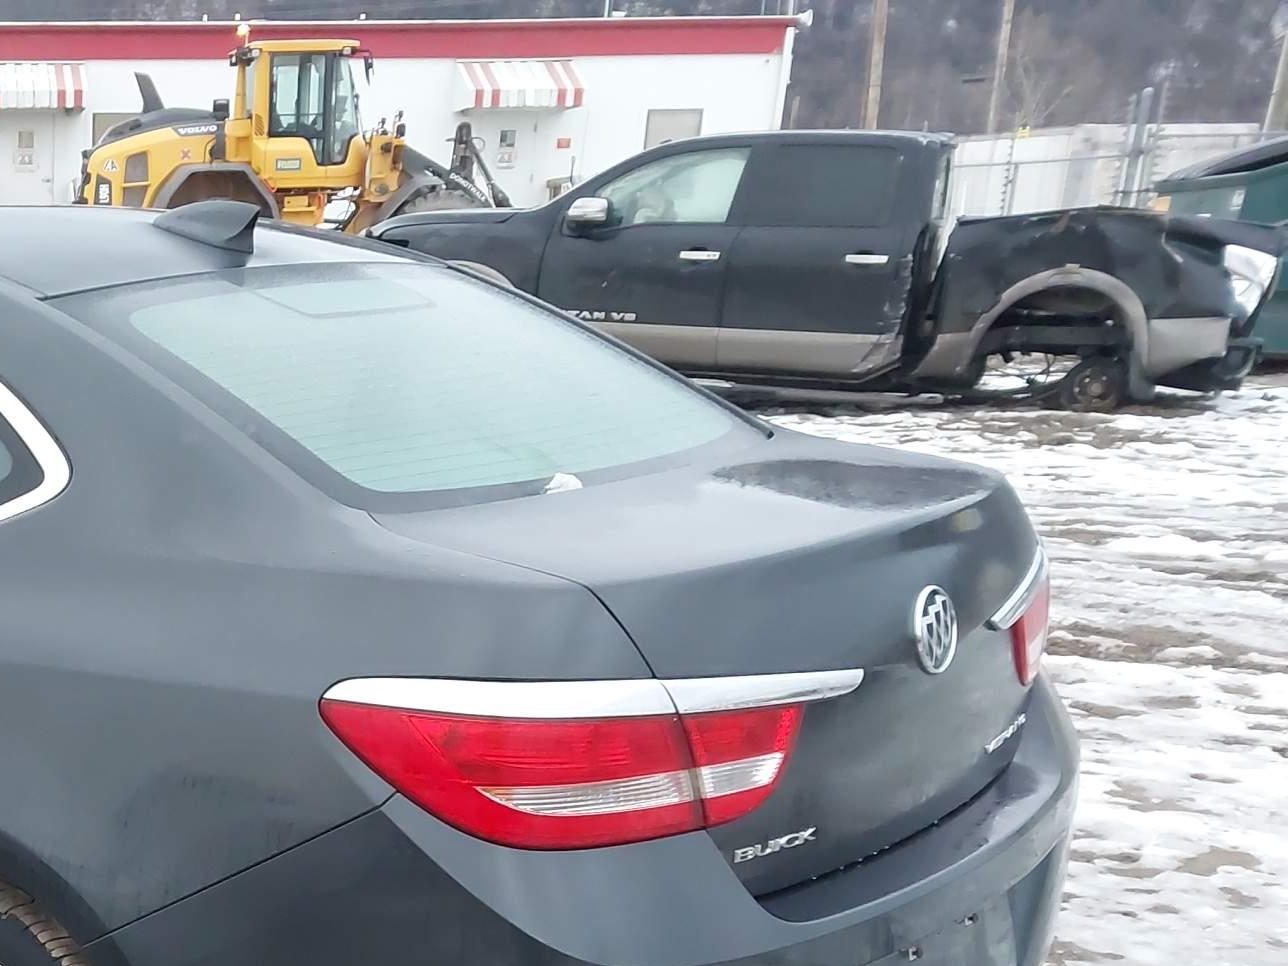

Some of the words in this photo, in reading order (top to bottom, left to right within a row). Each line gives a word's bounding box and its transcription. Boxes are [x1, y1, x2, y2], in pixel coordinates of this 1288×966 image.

[177, 125, 218, 135] VOLVO
[567, 310, 606, 320] TAN
[733, 826, 817, 864] BUICK
